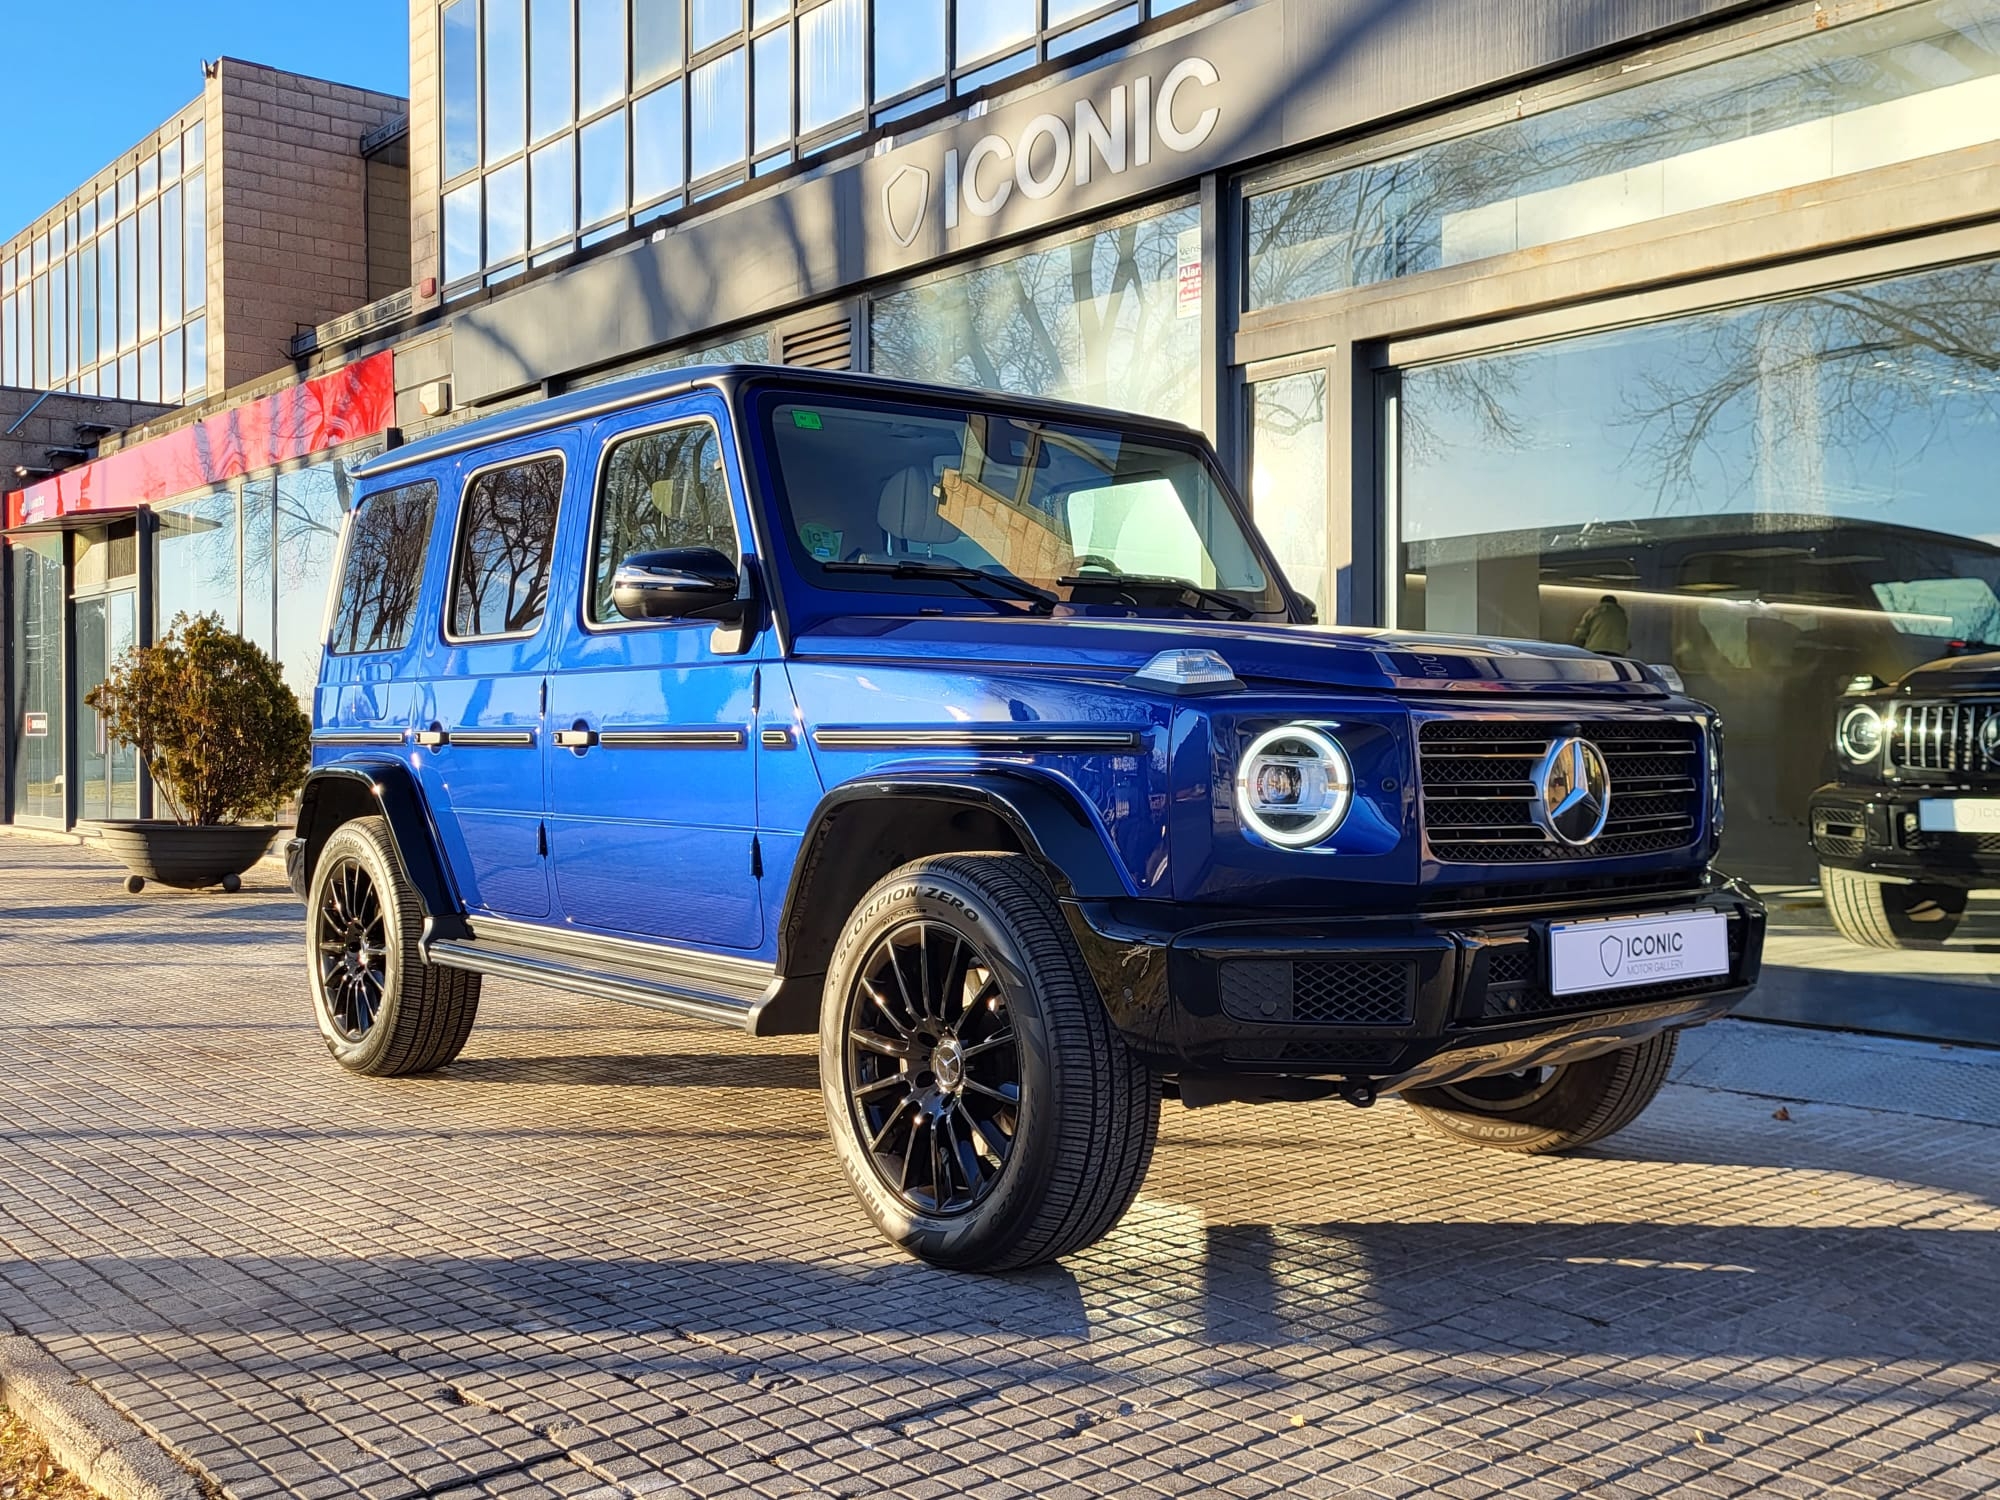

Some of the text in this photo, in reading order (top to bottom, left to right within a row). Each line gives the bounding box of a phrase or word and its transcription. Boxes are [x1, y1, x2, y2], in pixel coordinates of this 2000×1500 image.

[944, 57, 1220, 229] ICONIC
[839, 885, 979, 966] SCORPION ZERO
[1627, 932, 1683, 957] ICONIC
[1626, 960, 1684, 975] MOTOR GALLERY
